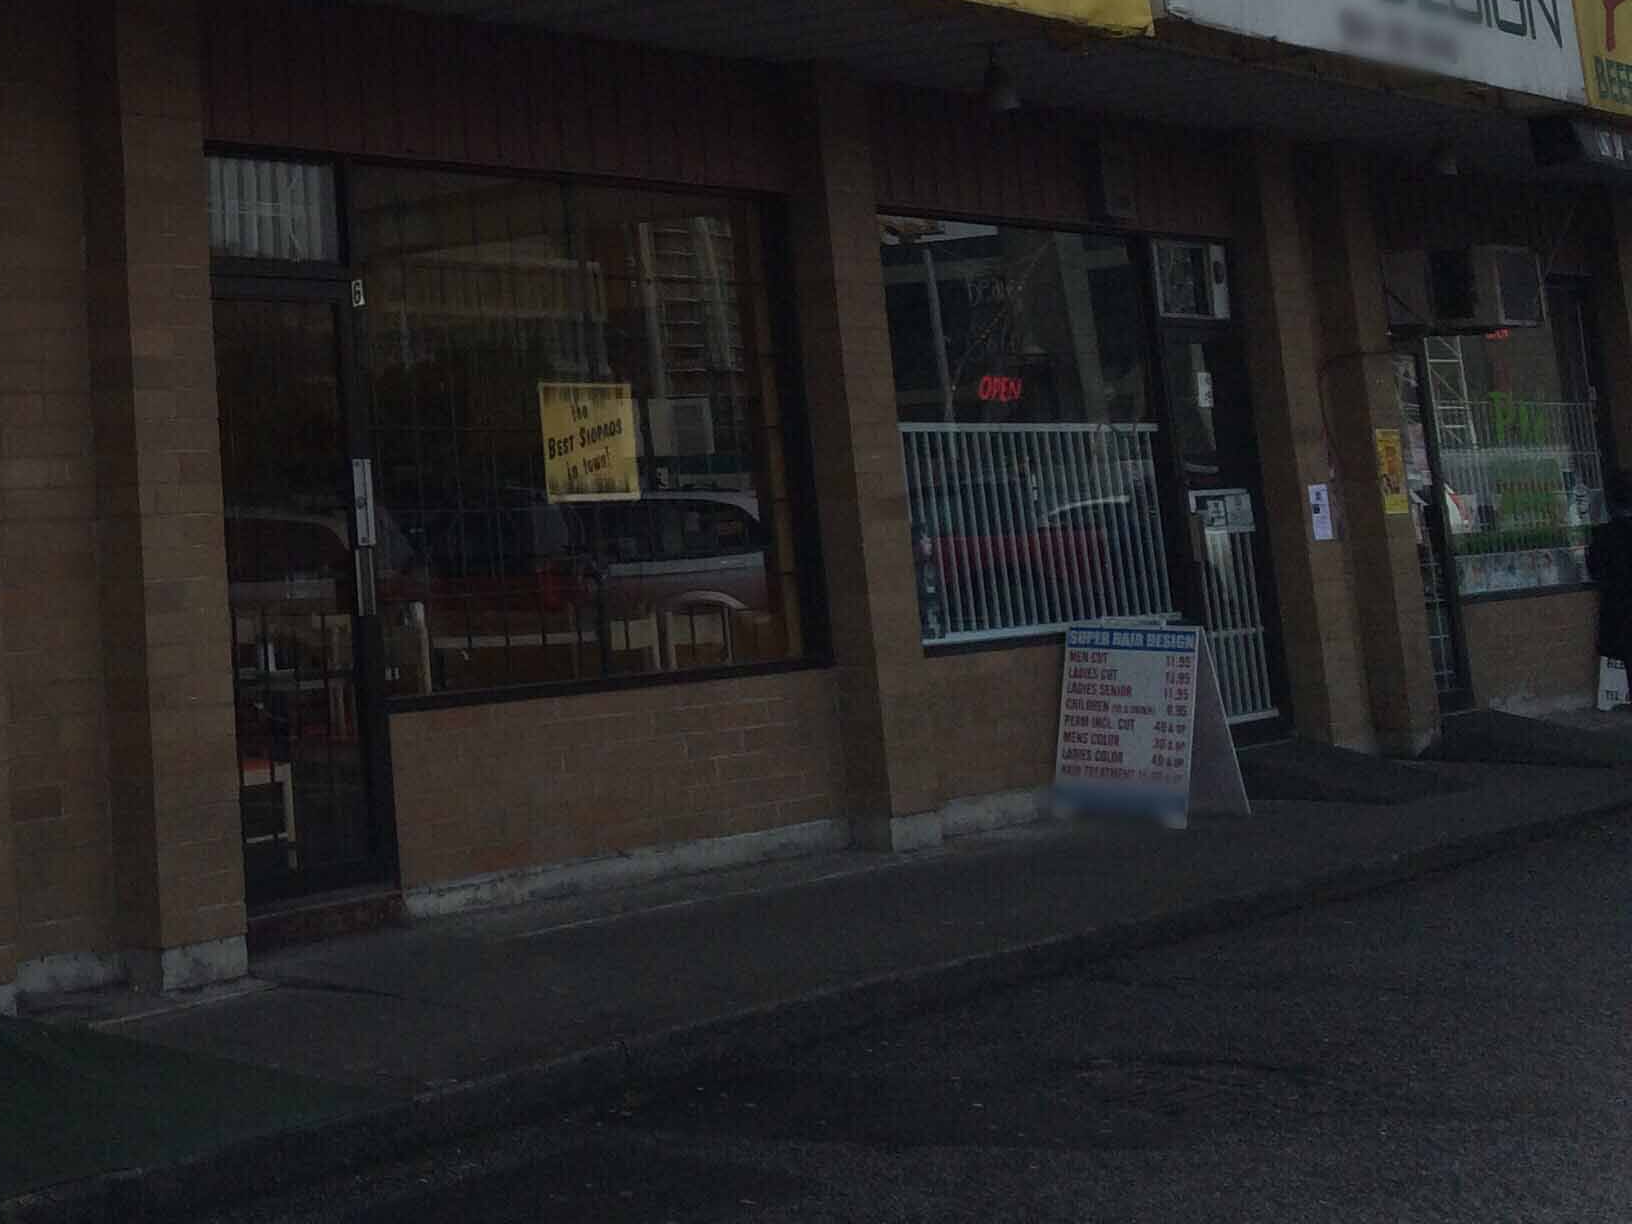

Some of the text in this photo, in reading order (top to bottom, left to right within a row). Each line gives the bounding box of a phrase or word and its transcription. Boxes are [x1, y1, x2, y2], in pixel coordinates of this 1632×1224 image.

[978, 376, 1023, 403] OPEN
[548, 435, 574, 460] BEST
[1069, 631, 1110, 645] SUPER
[1146, 633, 1194, 649] DESIGN
